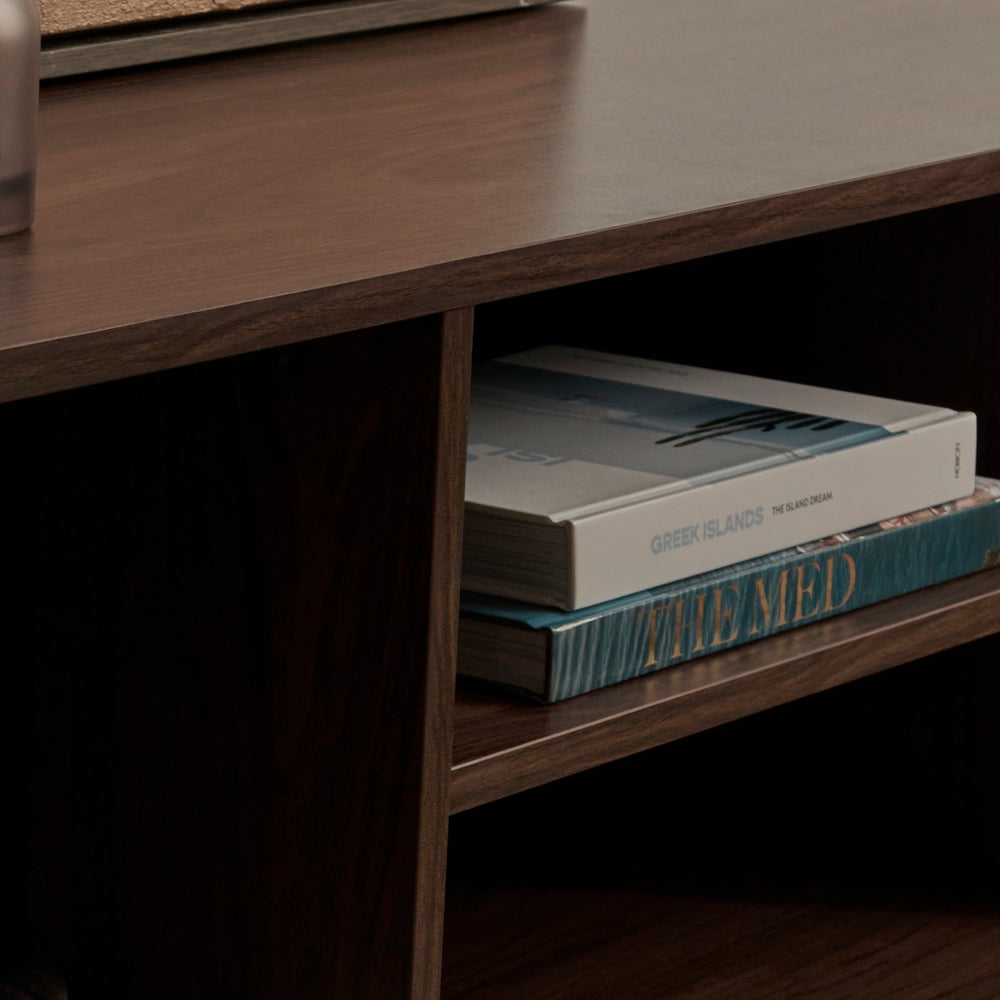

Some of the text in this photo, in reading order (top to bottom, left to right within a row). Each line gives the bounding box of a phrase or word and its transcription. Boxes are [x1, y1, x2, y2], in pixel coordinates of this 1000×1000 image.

[651, 506, 765, 555] GREEK ISLANDS
[771, 504, 785, 516] THE
[785, 498, 809, 512] ISLAND
[635, 551, 857, 667] THE MED
